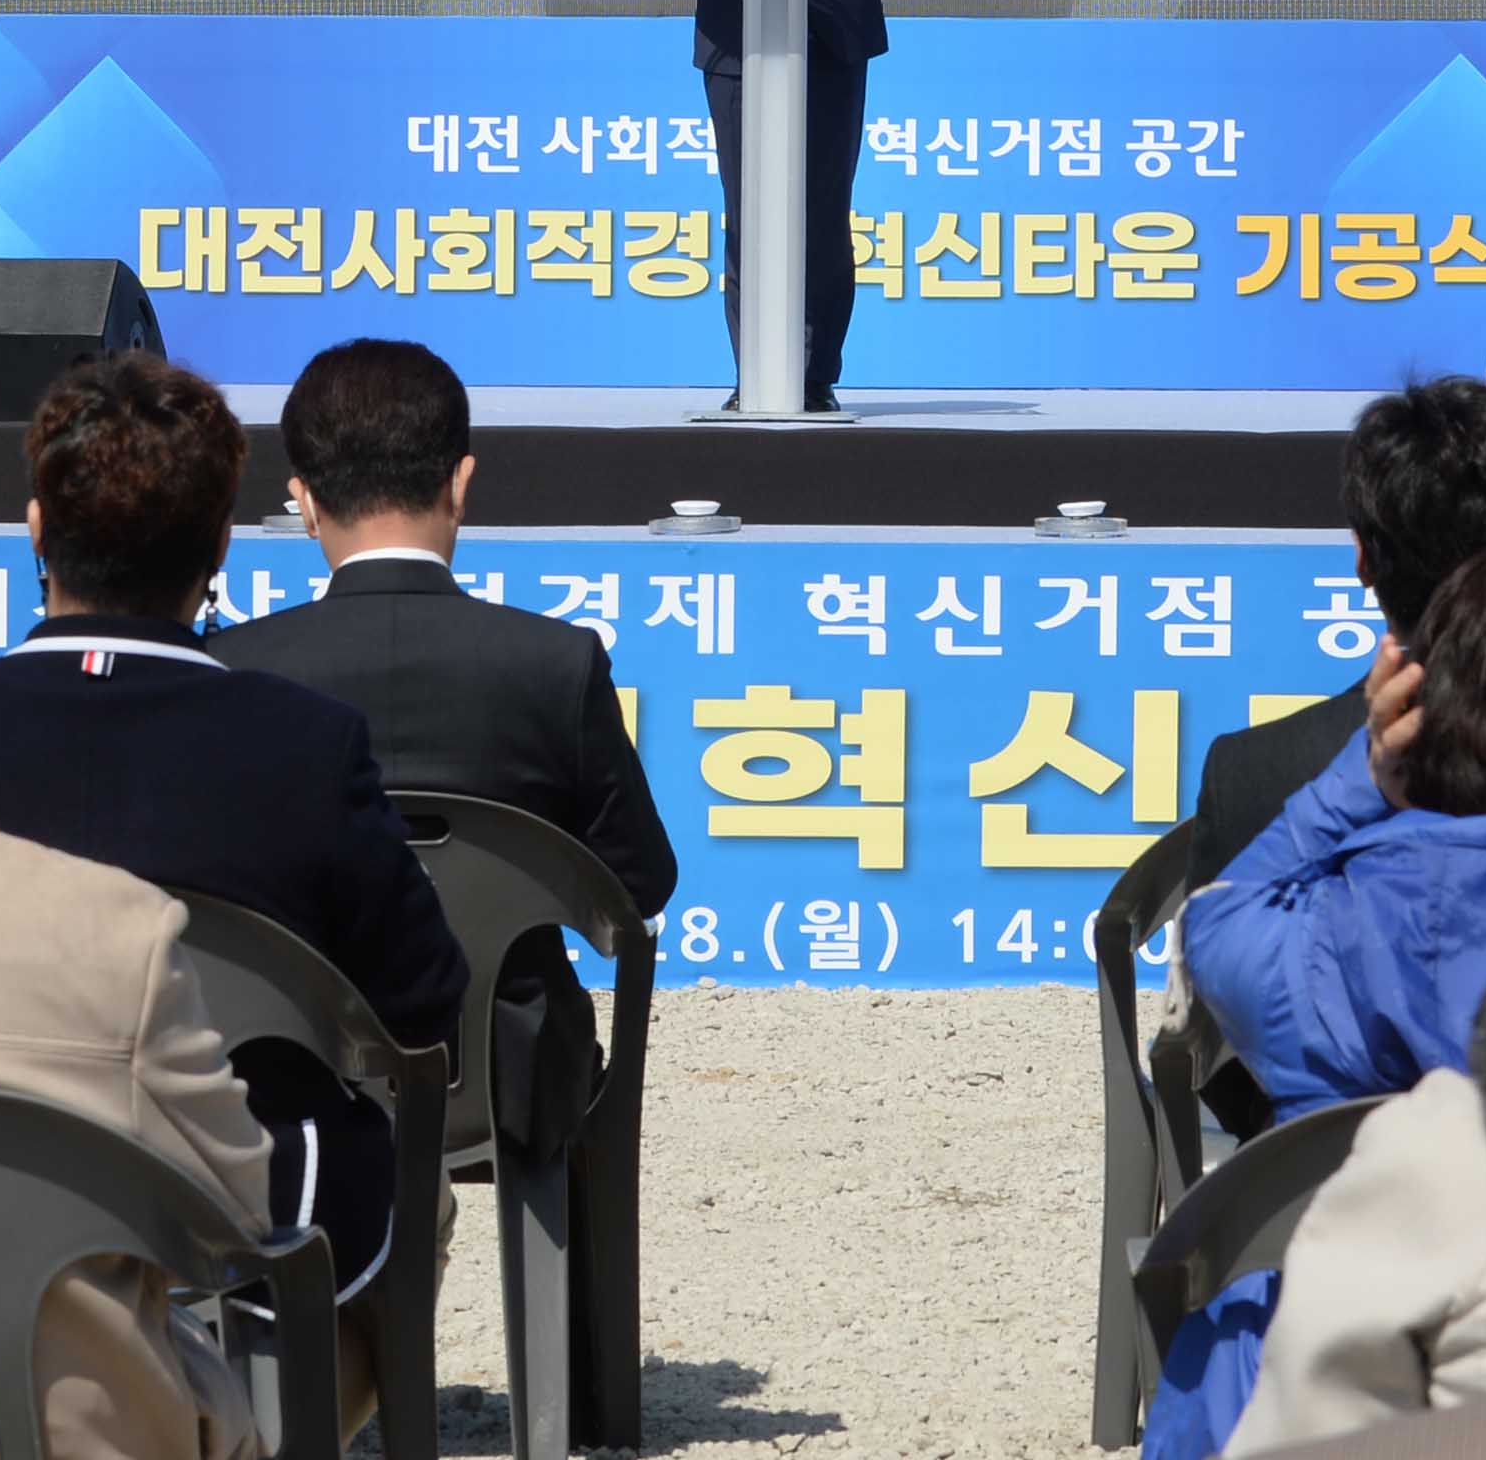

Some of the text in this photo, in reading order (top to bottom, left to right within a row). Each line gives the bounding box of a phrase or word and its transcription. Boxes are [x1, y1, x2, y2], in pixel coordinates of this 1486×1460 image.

[406, 114, 521, 174] 대전
[865, 116, 1103, 177] 혁신거점
[1125, 118, 1245, 178] 공간
[803, 573, 1233, 658] 혁신거점
